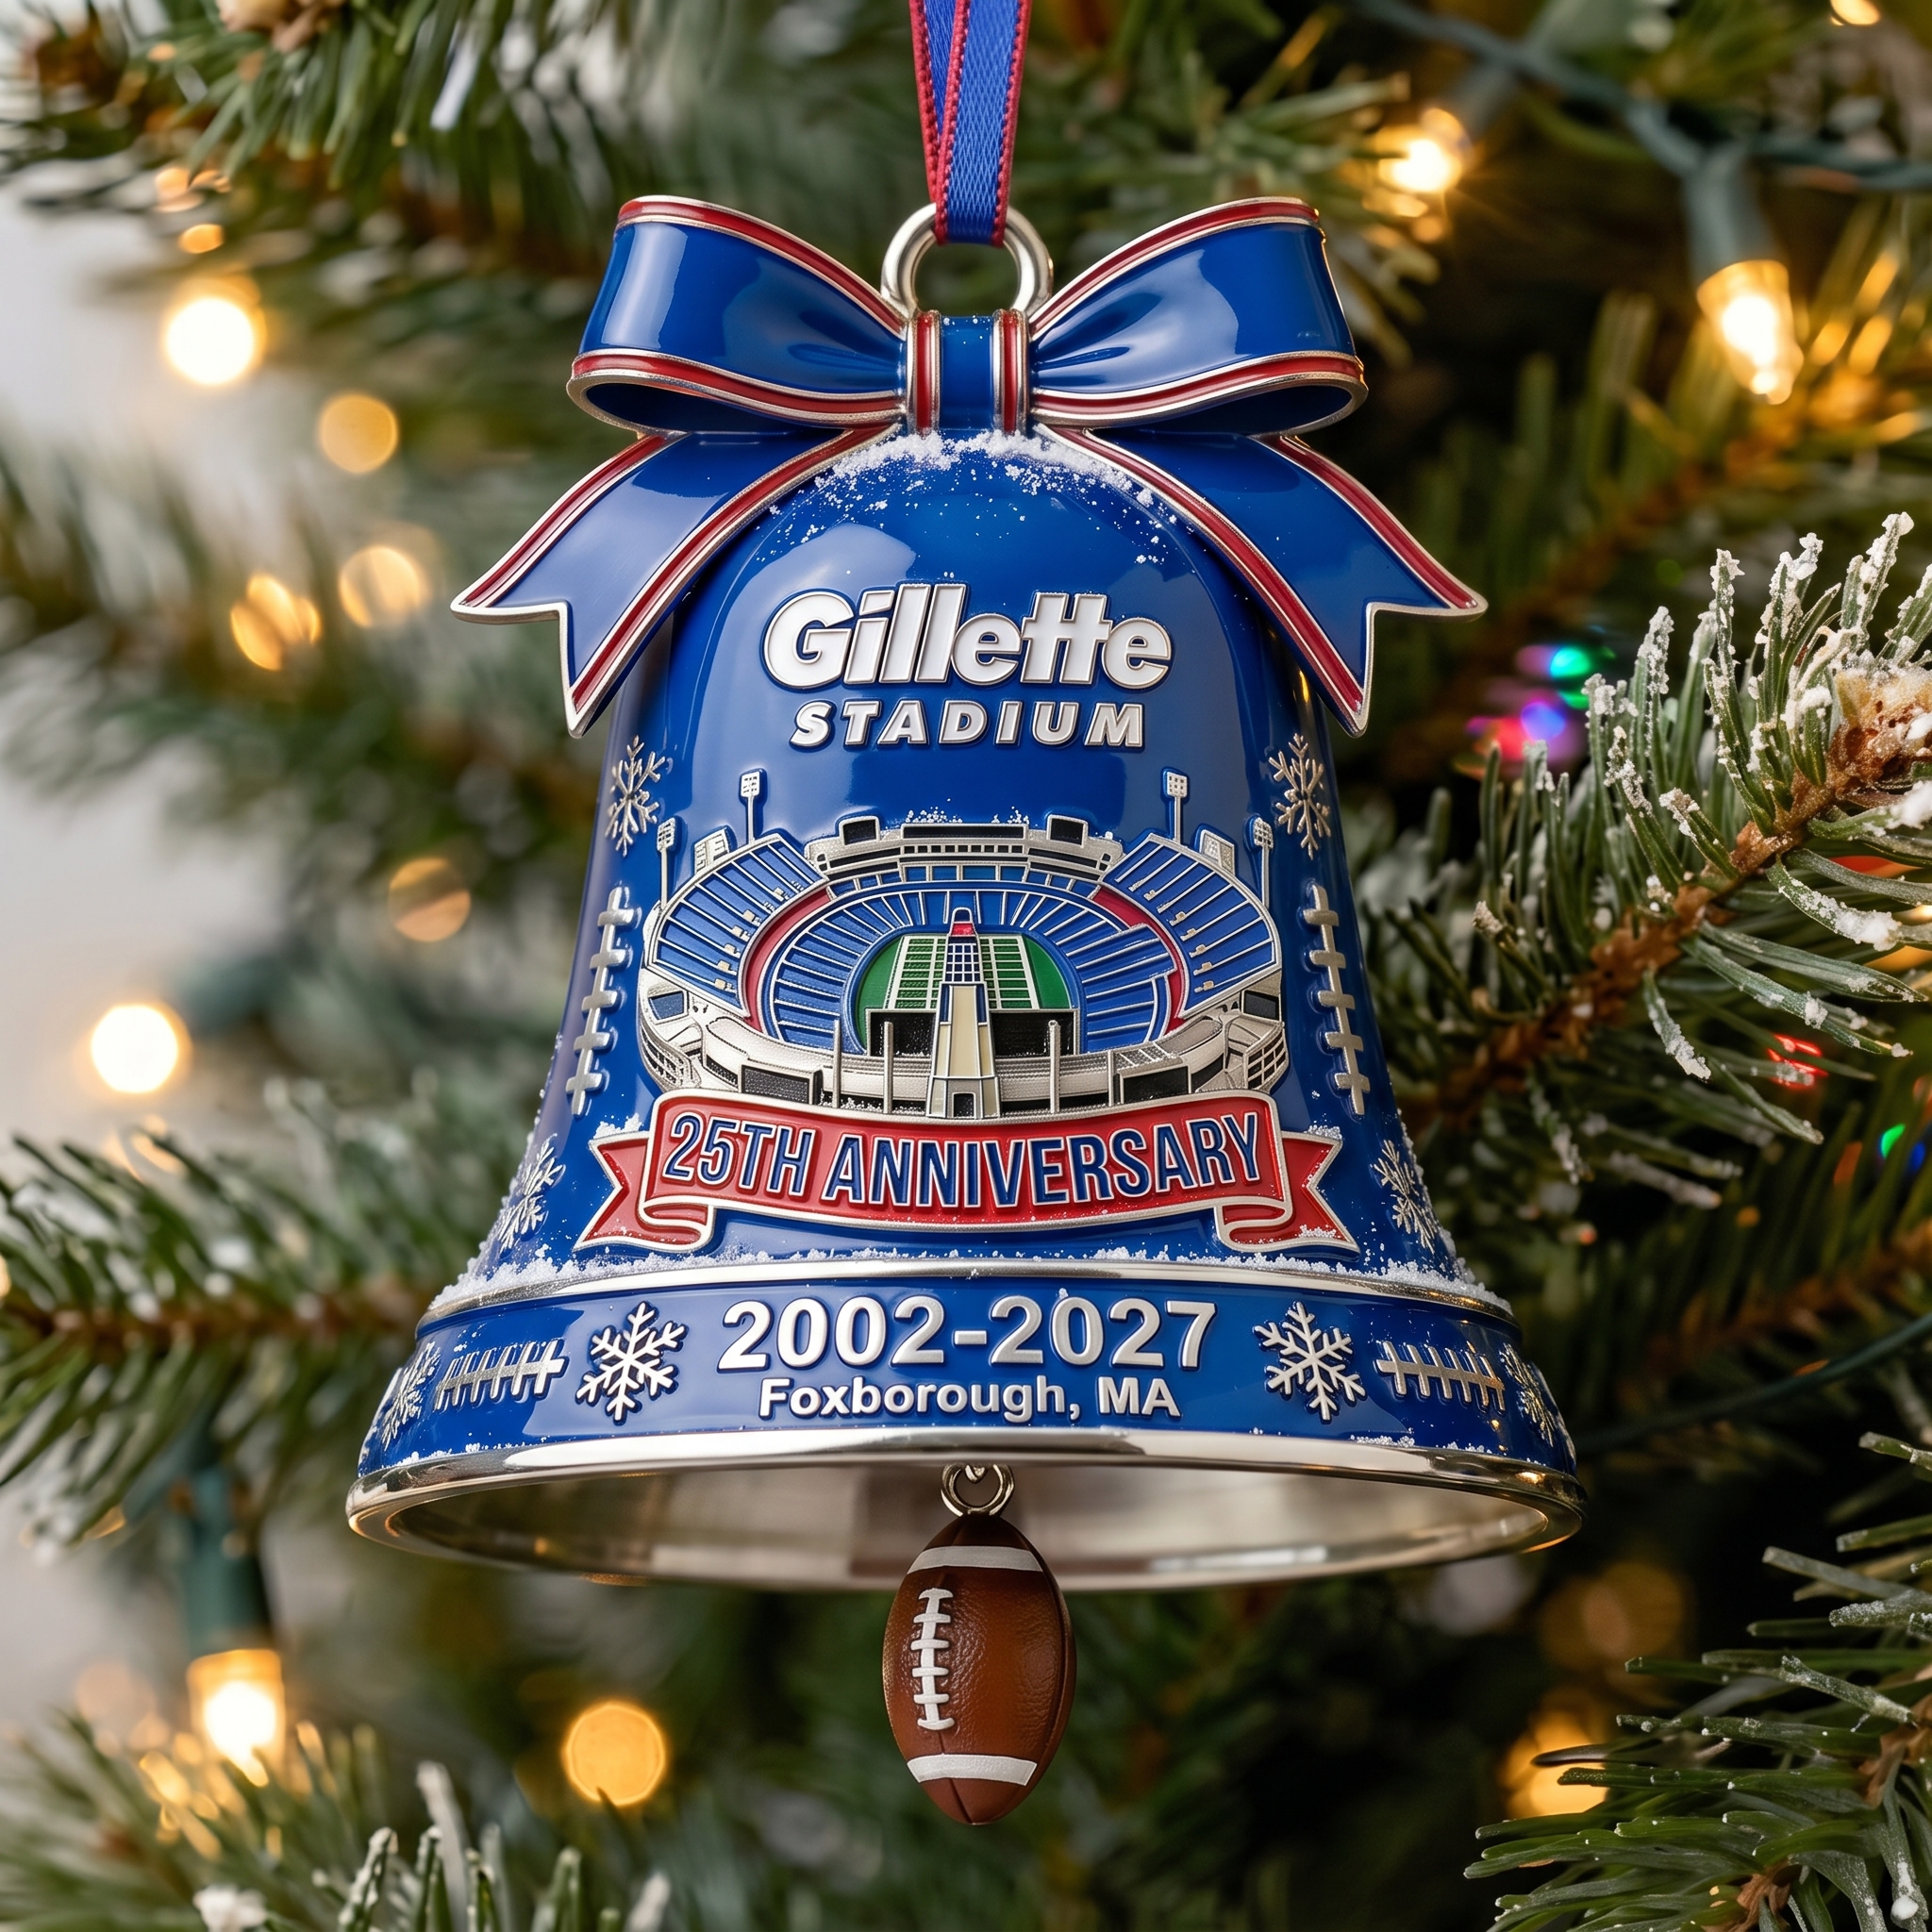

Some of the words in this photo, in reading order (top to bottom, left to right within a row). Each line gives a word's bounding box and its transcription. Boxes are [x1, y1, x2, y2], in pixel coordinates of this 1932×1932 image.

[763, 583, 1172, 688] Gillette
[790, 700, 1145, 747] STADIUM
[662, 1113, 816, 1196] 25TH
[821, 1111, 1261, 1208] ANNIVERSARY
[718, 1296, 1216, 1371] 2002-2027
[758, 1375, 1080, 1423] Foxborough,
[1097, 1376, 1181, 1417] MA
